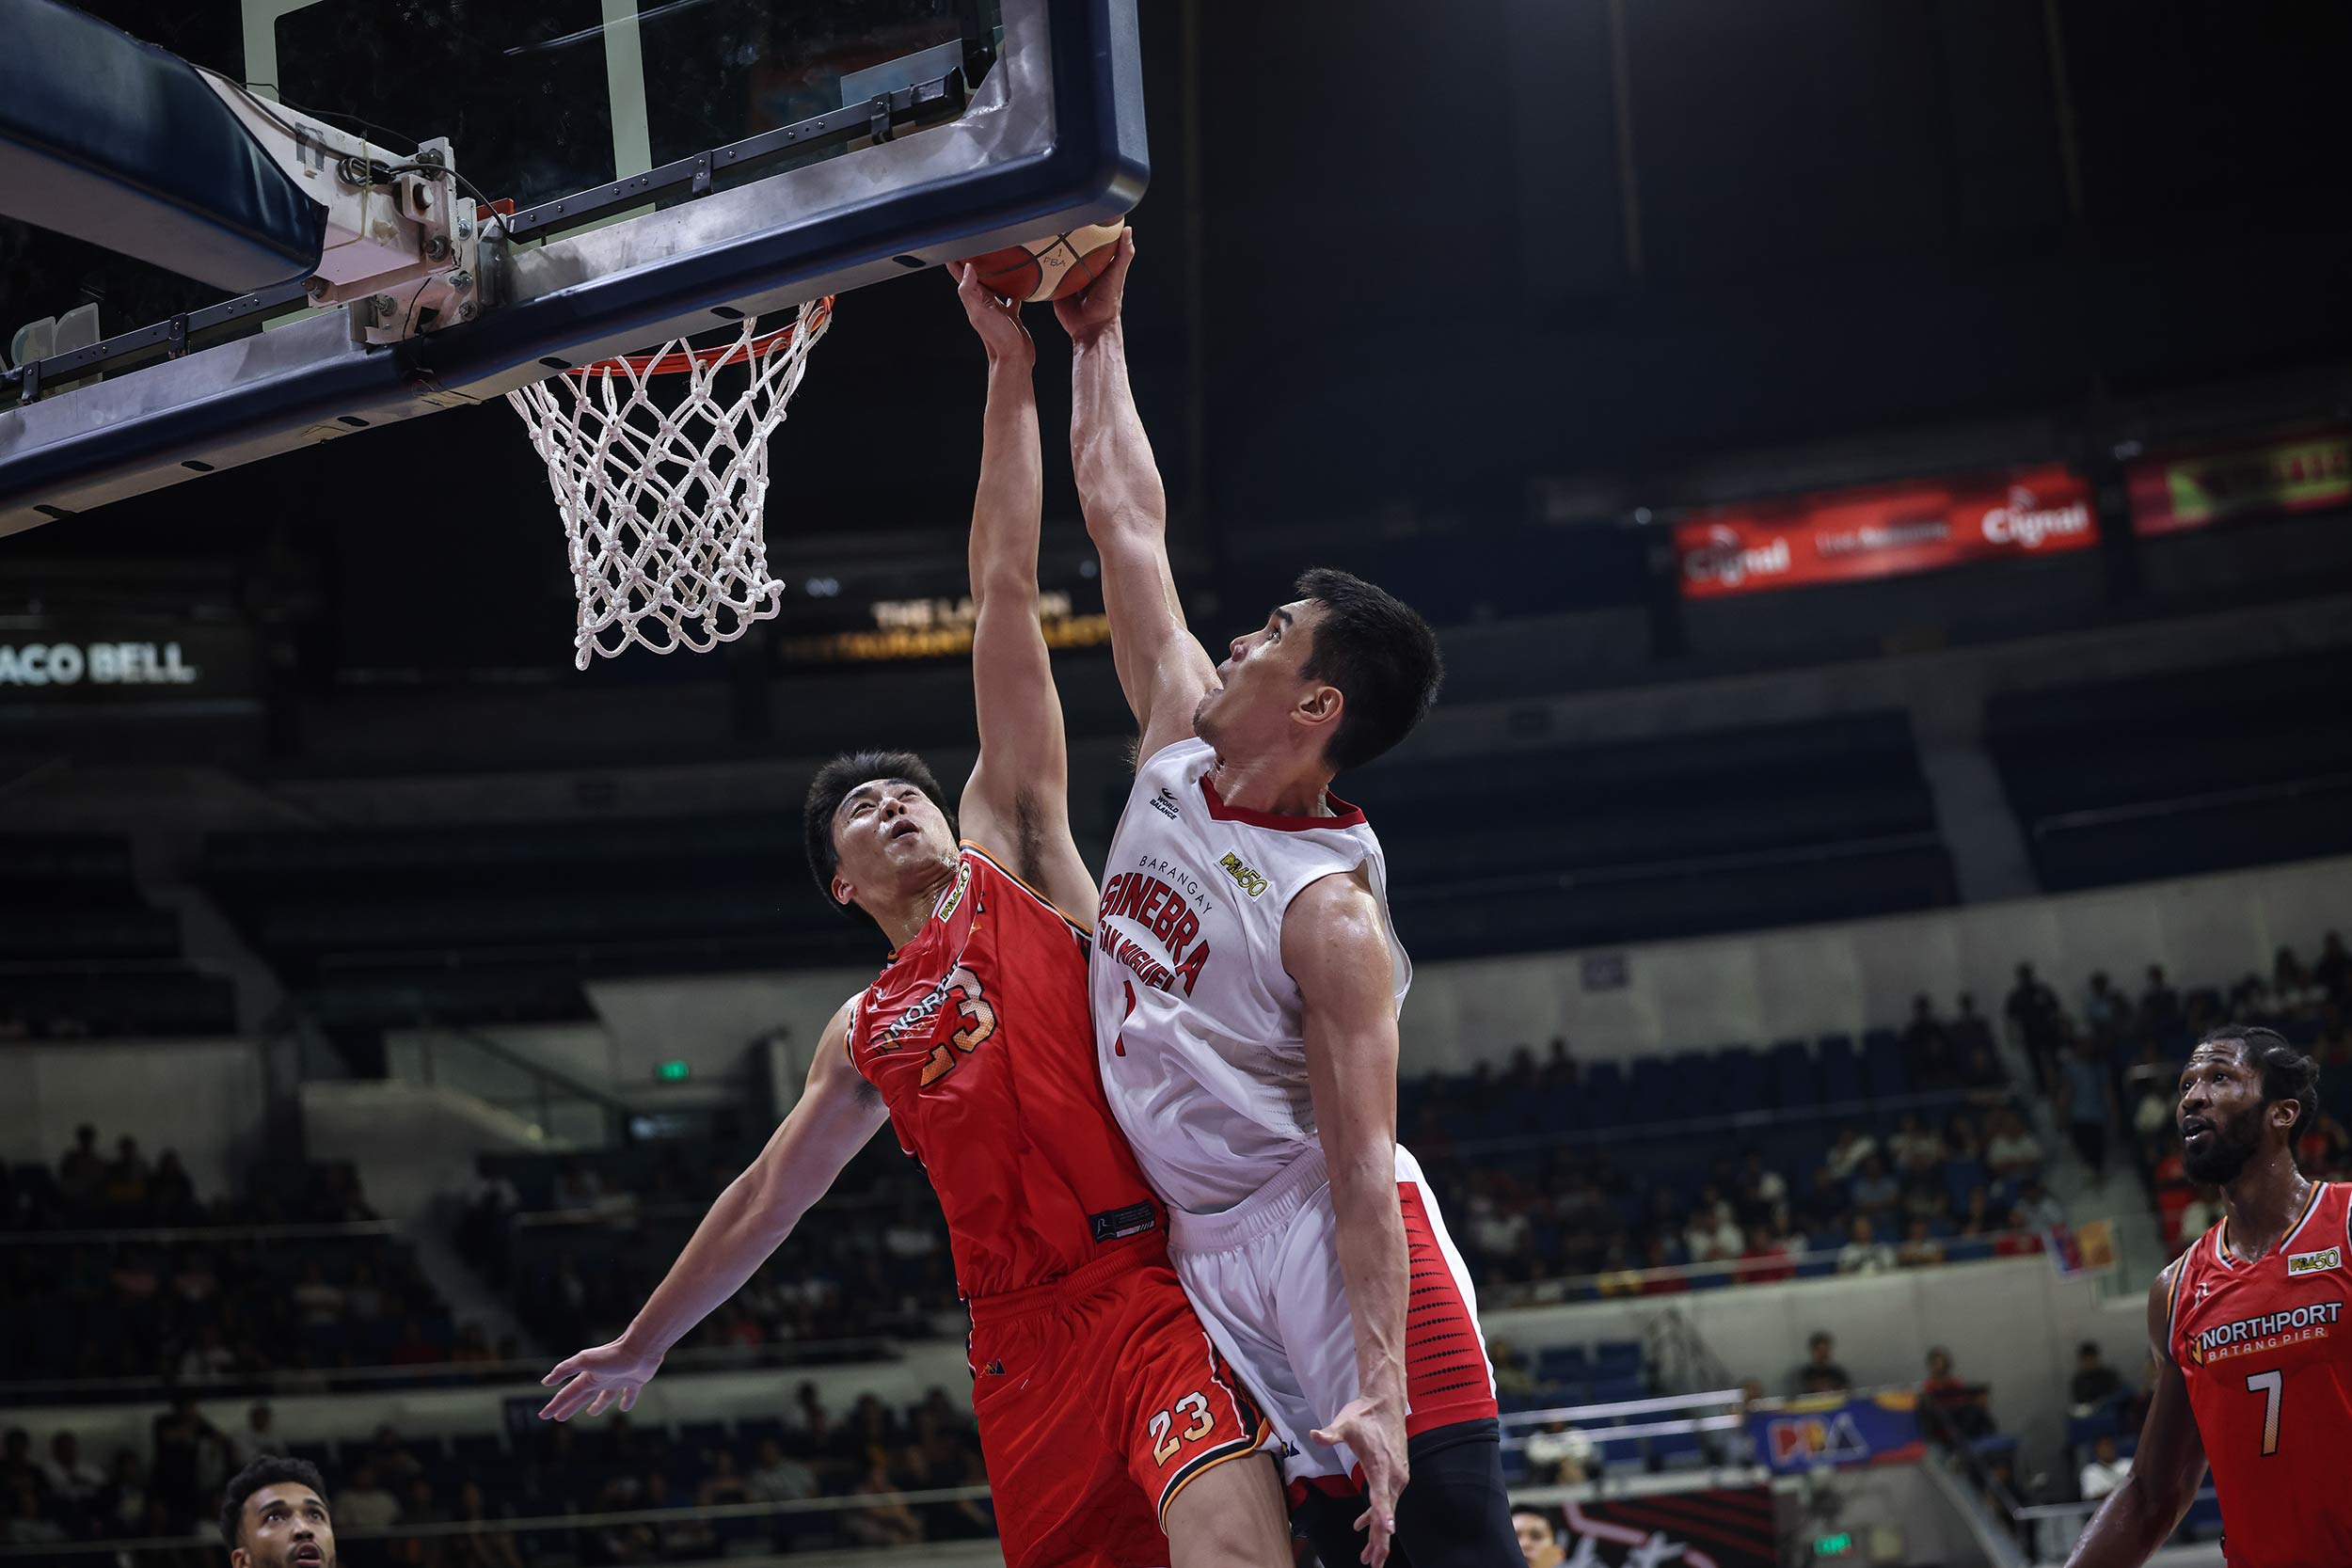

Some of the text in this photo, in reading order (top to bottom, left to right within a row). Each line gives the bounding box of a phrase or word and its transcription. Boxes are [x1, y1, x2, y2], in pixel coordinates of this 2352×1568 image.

[1042, 256, 1067, 267] PBA
[87, 641, 195, 685] BELL
[1150, 799, 1178, 821] BALANCE
[1157, 795, 1180, 814] WORLD
[1138, 855, 1213, 915] BARANGAY
[1098, 872, 1210, 999] GINEBRA
[2201, 1302, 2343, 1350] NORTHPORT
[2208, 1326, 2326, 1362] BATANG PIER
[1148, 1390, 1216, 1468] 23
[2246, 1369, 2283, 1457] 7
